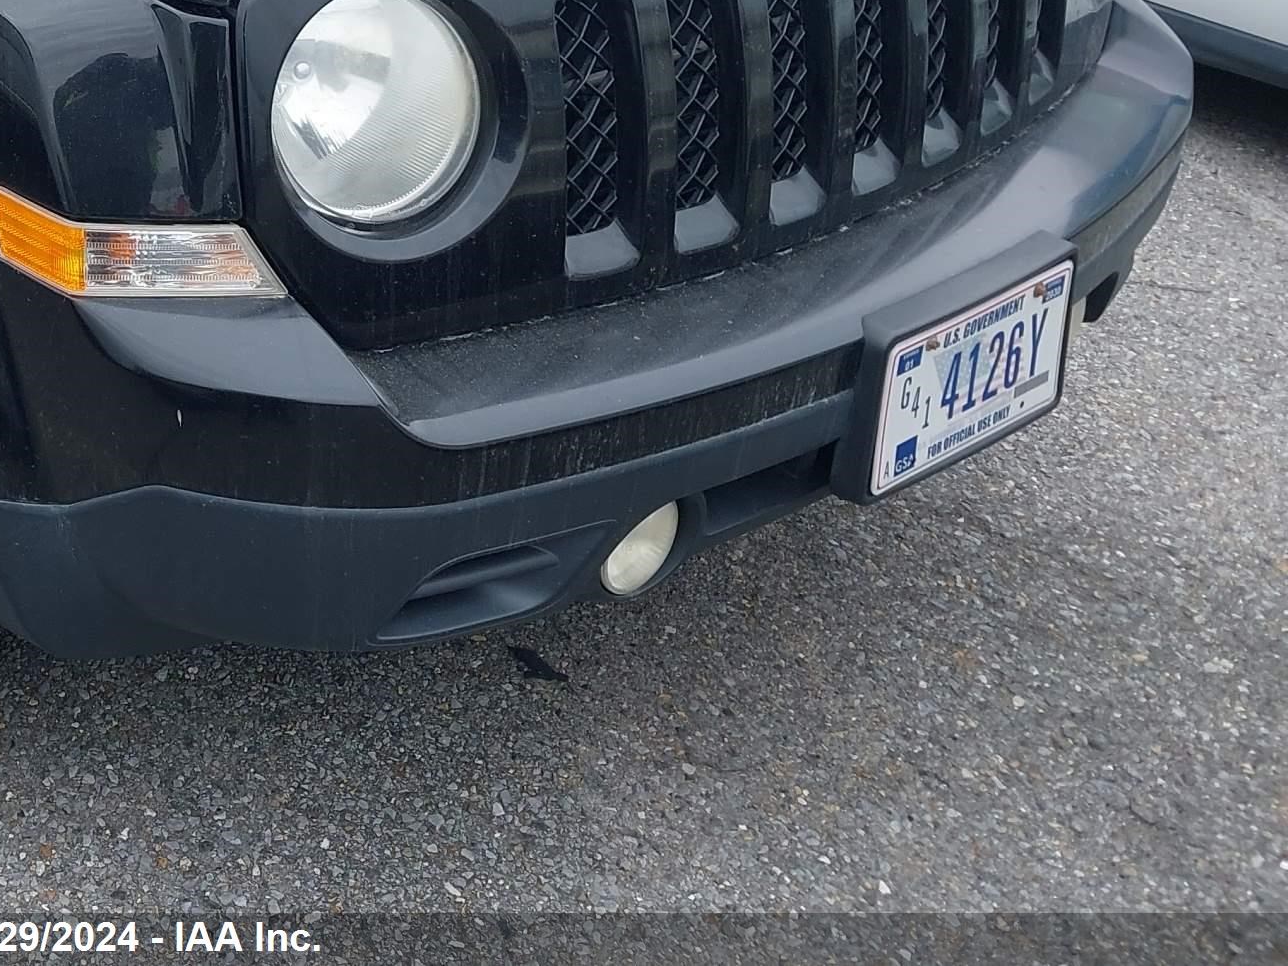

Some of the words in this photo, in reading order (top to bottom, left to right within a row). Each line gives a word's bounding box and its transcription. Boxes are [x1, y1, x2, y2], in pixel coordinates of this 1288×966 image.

[943, 326, 961, 349] U.S.
[963, 293, 1026, 339] GOVERNMENT
[940, 307, 1049, 420] 4126Y
[927, 441, 942, 459] FOR
[943, 422, 976, 450] OFFICIAL
[977, 414, 991, 433] USE
[993, 403, 1011, 425] ONLY
[895, 453, 913, 472] GSA
